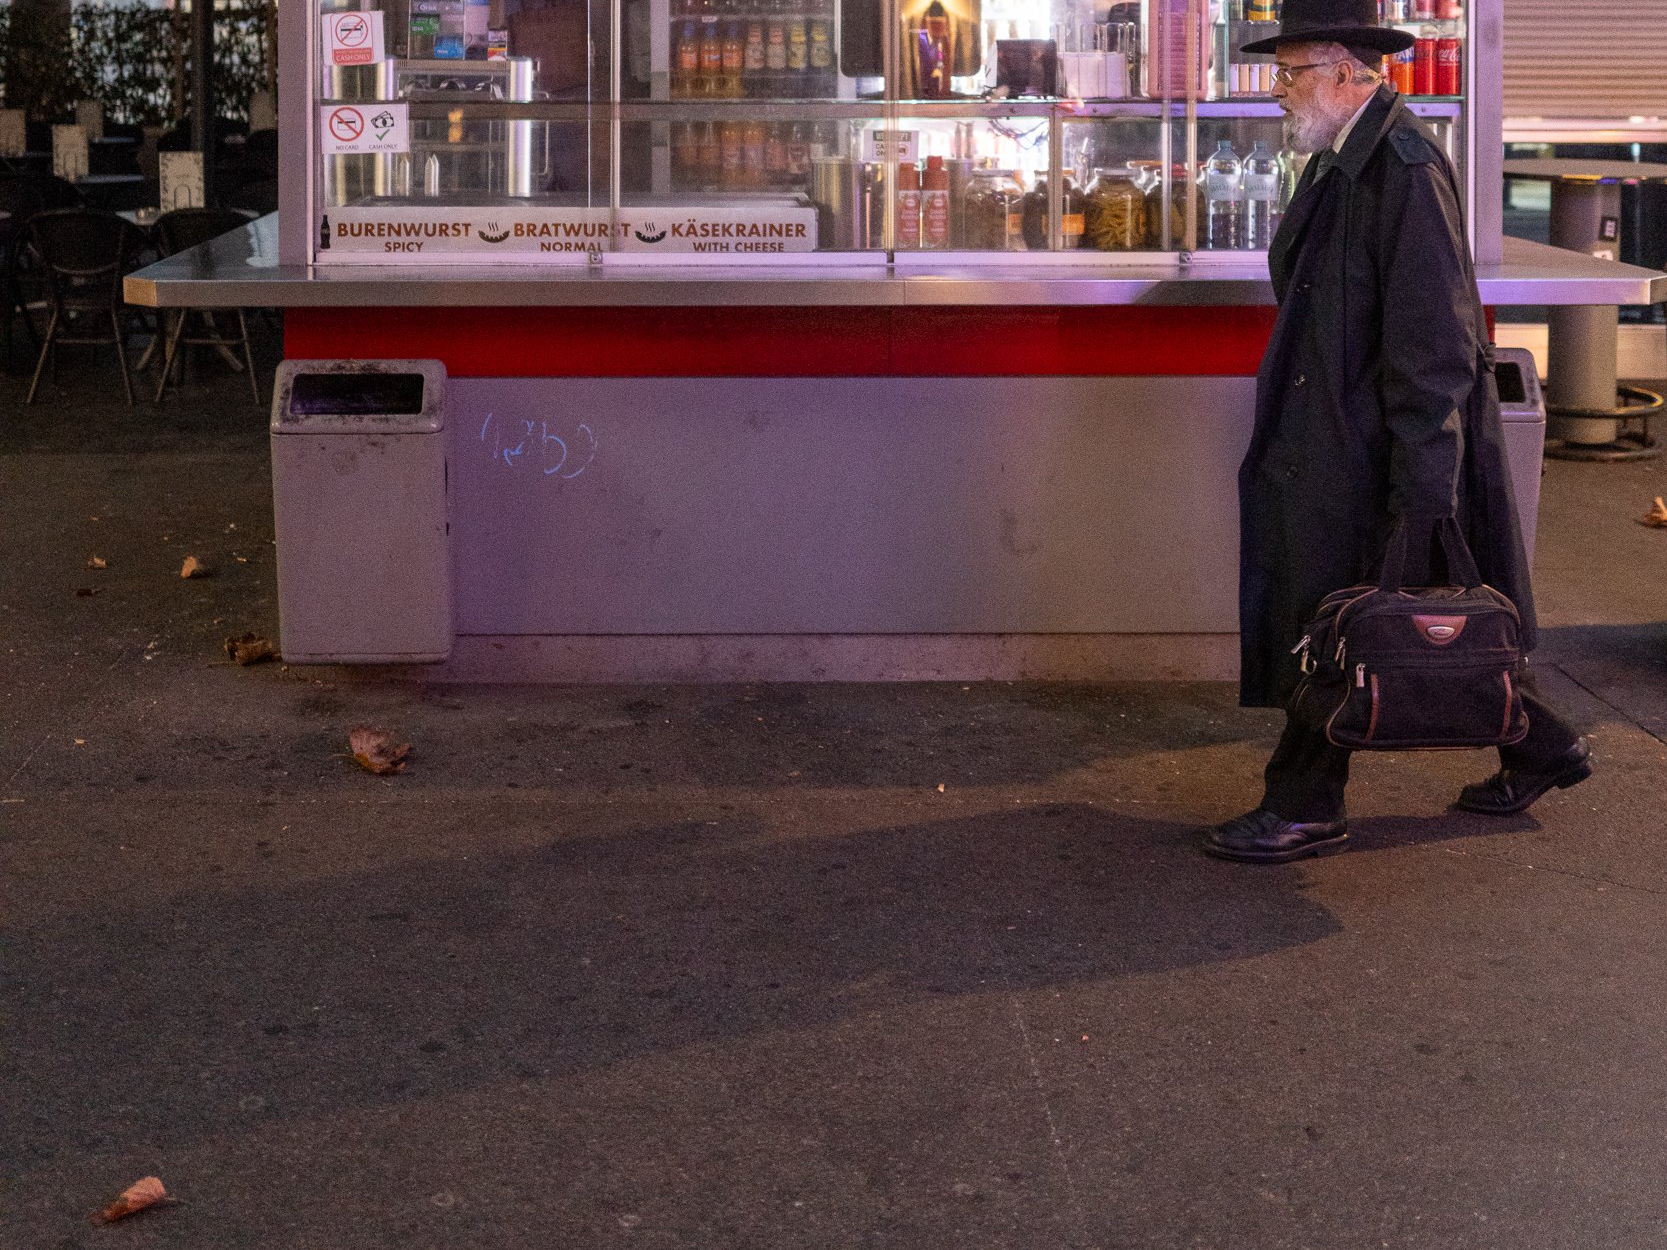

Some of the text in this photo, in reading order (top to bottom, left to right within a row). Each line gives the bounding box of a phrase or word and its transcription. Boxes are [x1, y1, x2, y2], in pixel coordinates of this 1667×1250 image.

[336, 52, 370, 62] CASH ONLY
[337, 218, 807, 238] BURENWURST BRATWURT KÄSEKRAINER
[384, 241, 424, 253] SPICY
[692, 242, 729, 252] WITH
[734, 242, 784, 252] CHEESE
